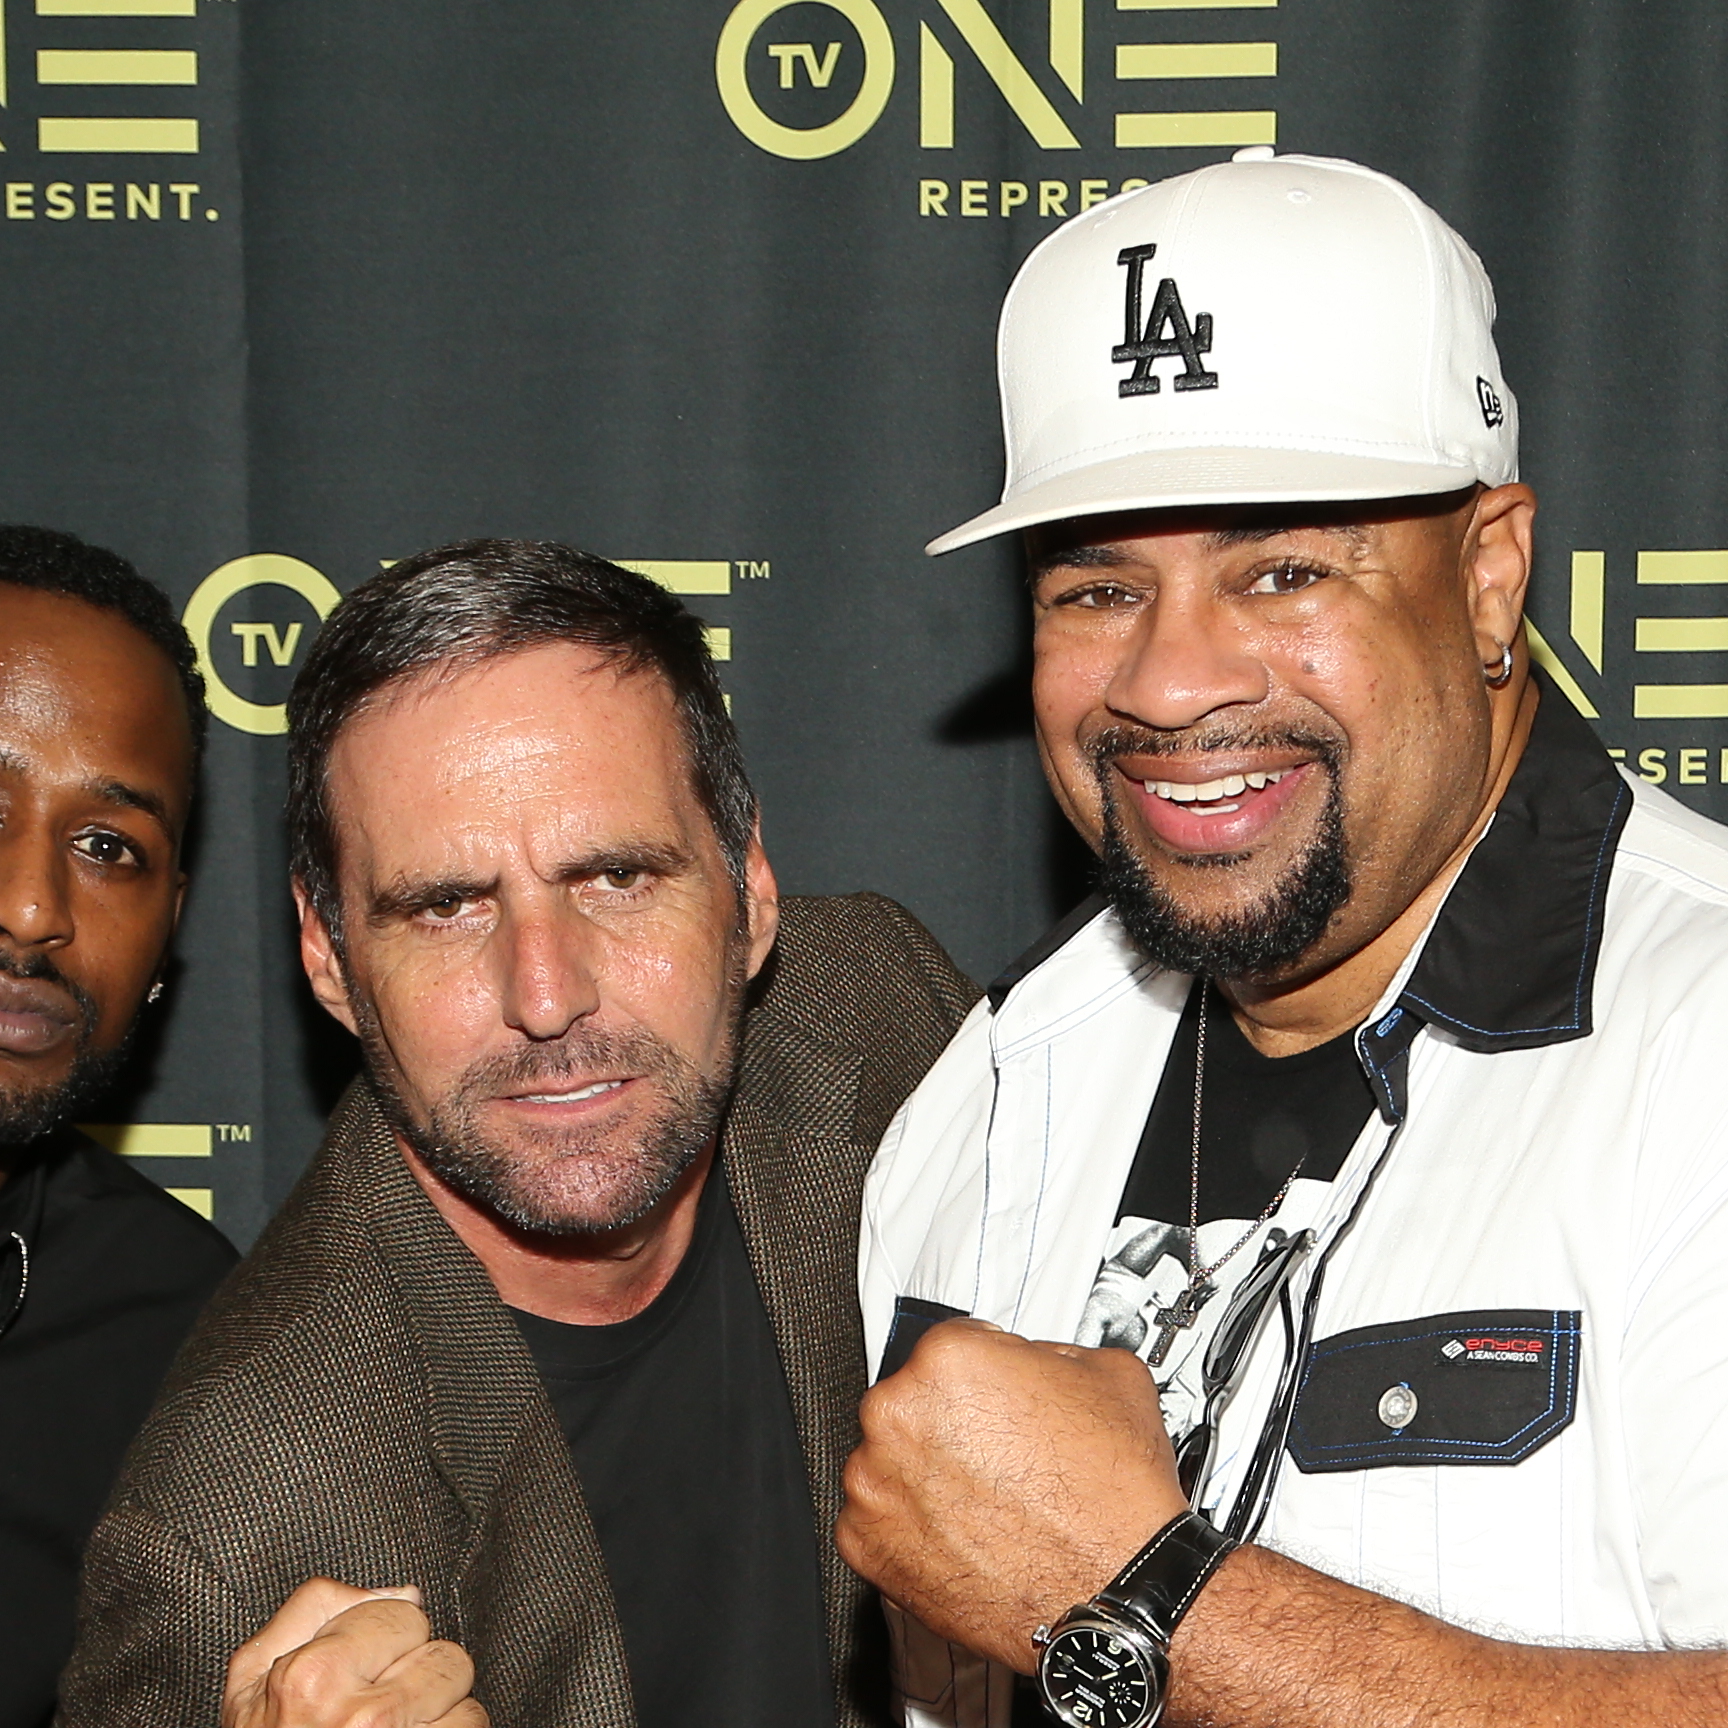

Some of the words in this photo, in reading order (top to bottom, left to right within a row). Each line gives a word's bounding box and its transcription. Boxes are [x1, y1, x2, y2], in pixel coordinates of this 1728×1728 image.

[715, 0, 1278, 160] ONE
[768, 42, 842, 89] TV
[919, 178, 1149, 218] REPRE
[1111, 243, 1219, 399] LA
[231, 622, 302, 667] TV
